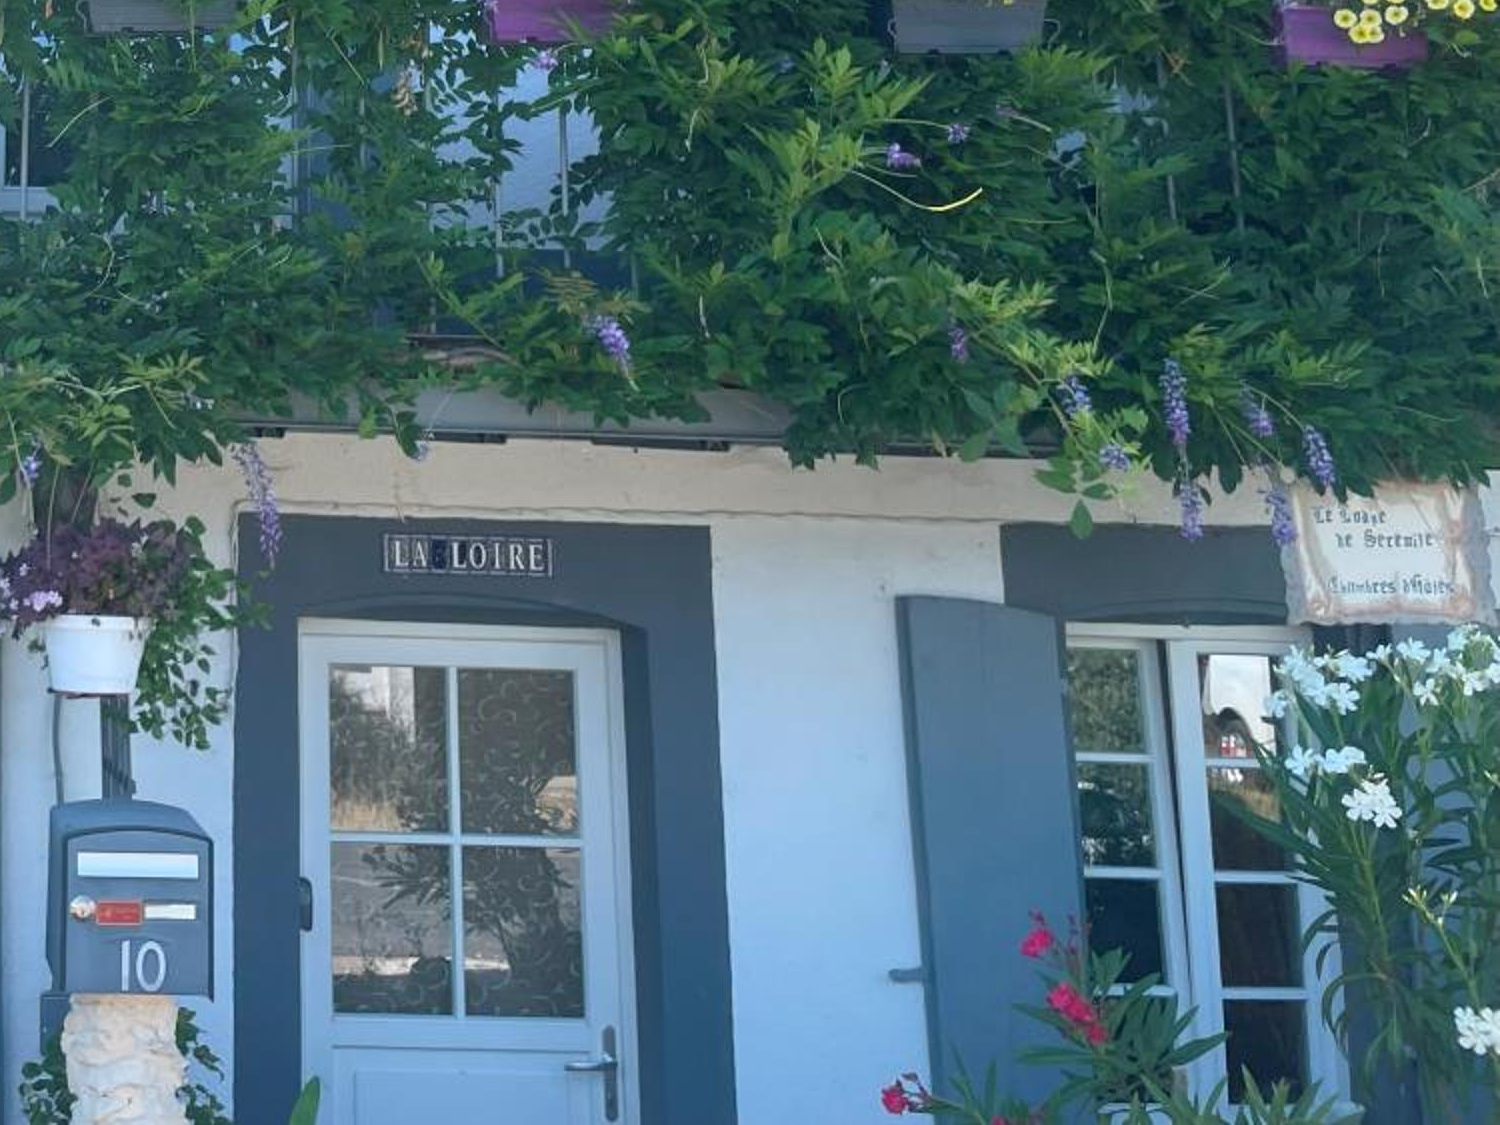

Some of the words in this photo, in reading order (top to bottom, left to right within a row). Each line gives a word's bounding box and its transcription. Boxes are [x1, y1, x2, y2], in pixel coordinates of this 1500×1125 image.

[1312, 506, 1333, 524] Le
[1335, 533, 1353, 548] de
[395, 540, 427, 567] LA
[452, 542, 544, 571] LOIRE
[121, 939, 167, 992] 10
